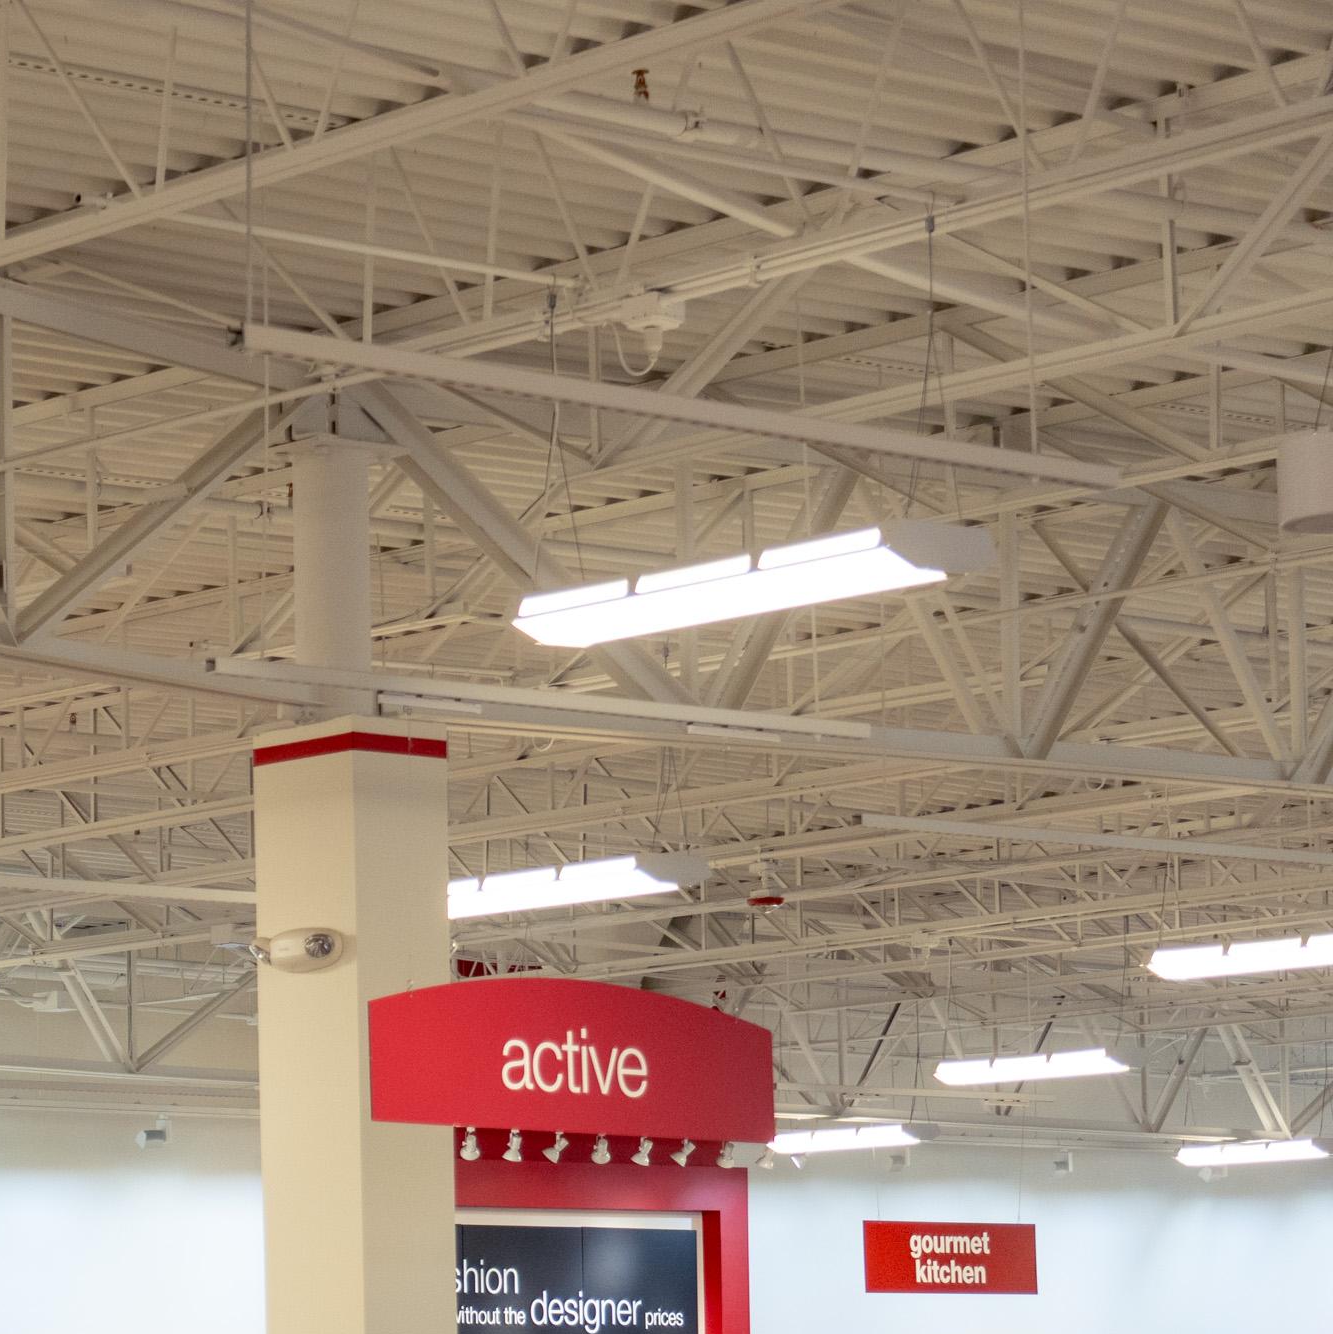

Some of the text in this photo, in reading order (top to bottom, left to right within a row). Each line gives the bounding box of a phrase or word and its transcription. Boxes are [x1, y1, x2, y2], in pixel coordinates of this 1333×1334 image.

[500, 1026, 649, 1099] active
[909, 1231, 991, 1258] gourmet
[914, 1259, 988, 1285] kitchen
[503, 1306, 527, 1325] the
[530, 1290, 644, 1334] designer
[644, 1308, 685, 1330] prices
